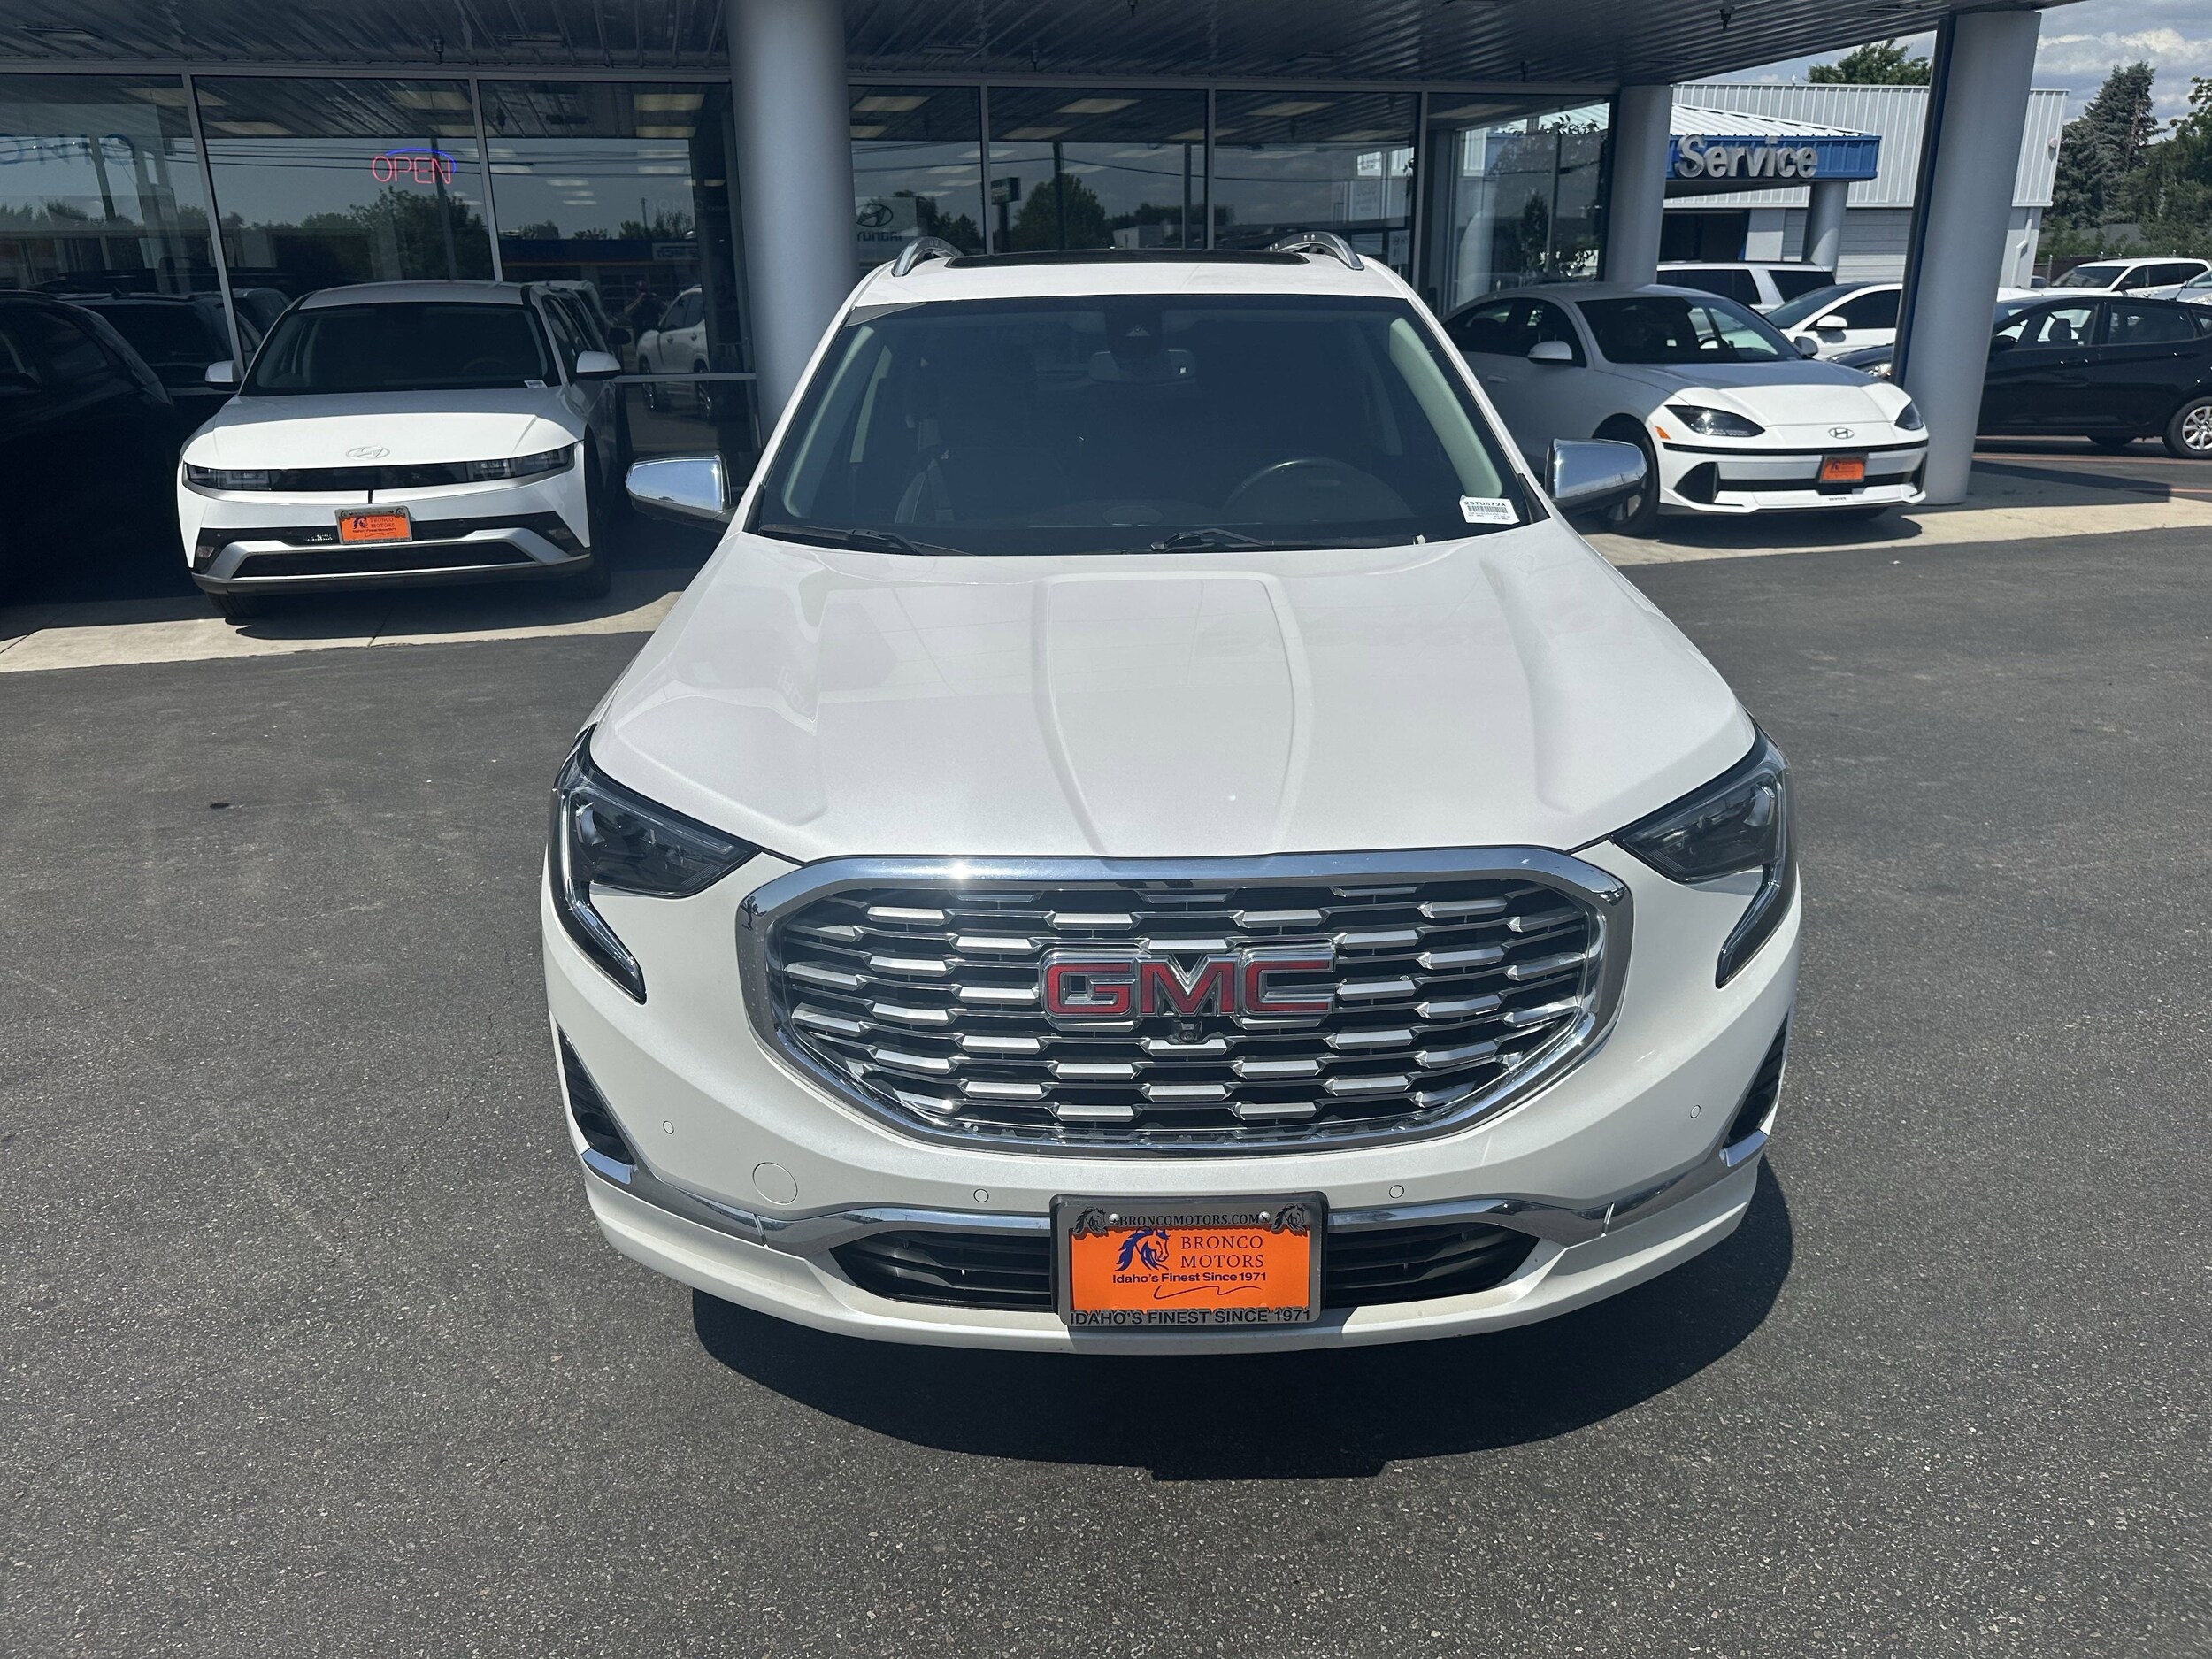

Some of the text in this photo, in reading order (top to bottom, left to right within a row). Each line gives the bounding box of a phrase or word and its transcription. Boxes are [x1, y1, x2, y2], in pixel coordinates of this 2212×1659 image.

[1675, 134, 1817, 178] Service
[372, 155, 451, 184] OPEN
[856, 231, 902, 242] YUNDAI
[1042, 955, 1333, 1018] GMC
[1118, 1213, 1260, 1227] BRONCOMOTORS.COM
[1180, 1235, 1263, 1250] BRONCO
[1180, 1254, 1264, 1269] MOTORS
[1112, 1271, 1266, 1284] Idaho's Finest Since 1971
[1069, 1309, 1311, 1325] IDAHO'S FINEST SINCE 1971
